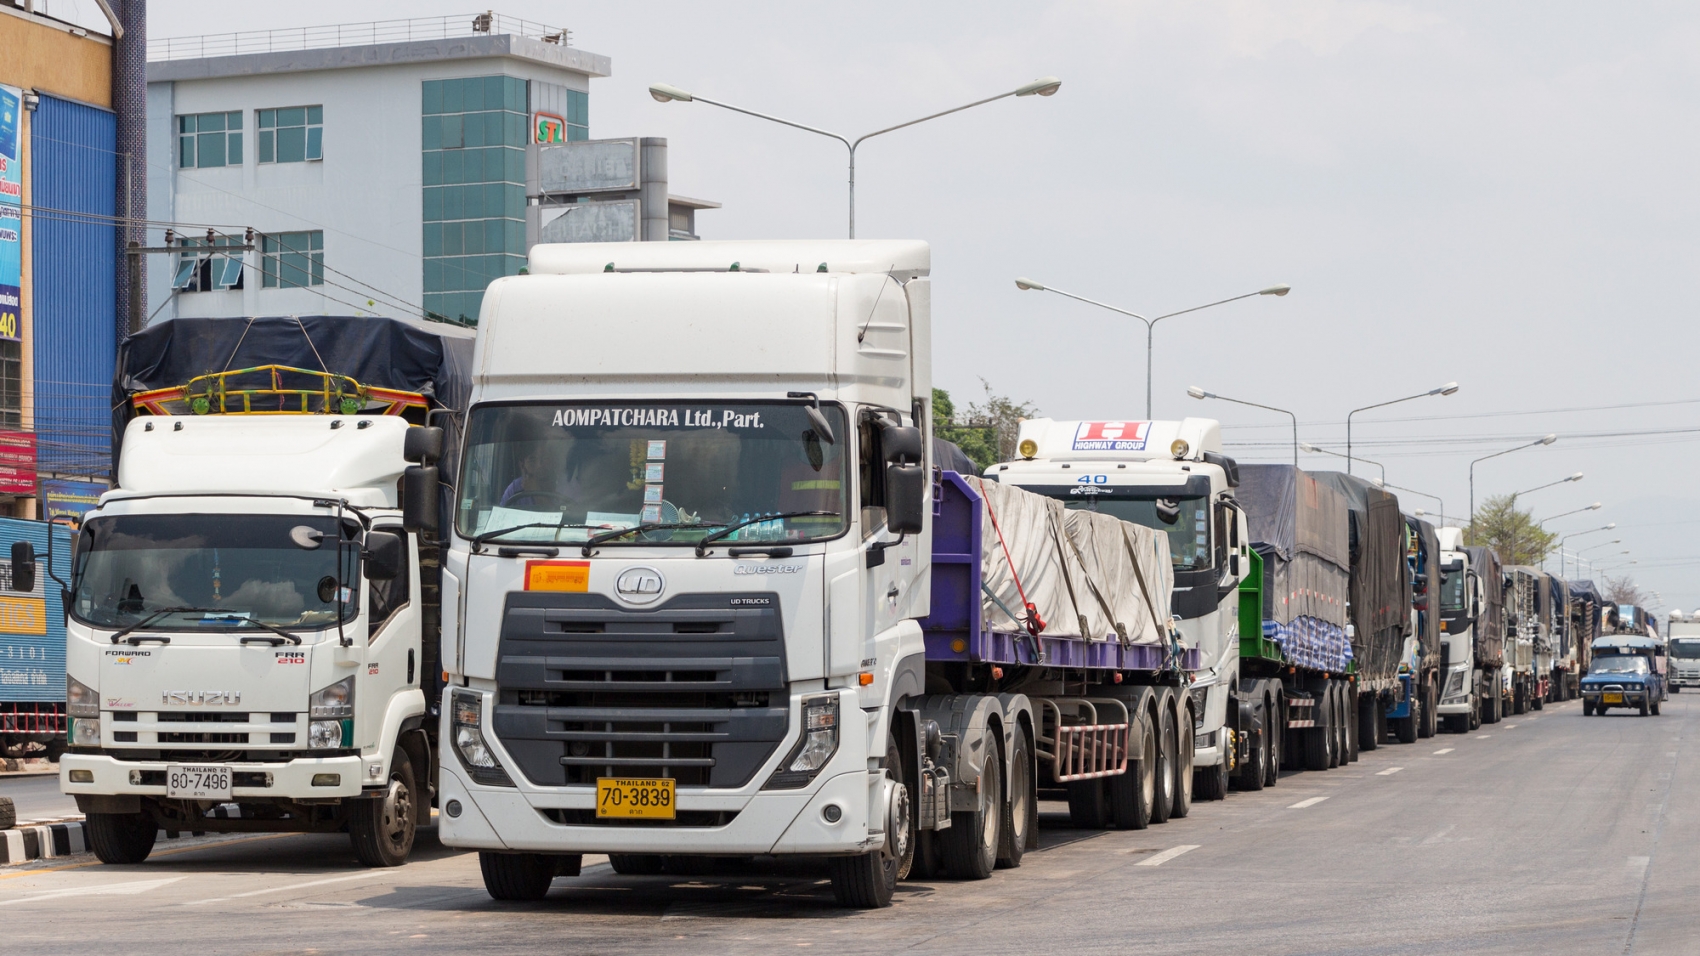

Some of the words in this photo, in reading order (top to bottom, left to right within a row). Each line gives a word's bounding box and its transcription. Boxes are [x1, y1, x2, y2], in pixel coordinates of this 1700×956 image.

[537, 119, 563, 143] STL
[552, 408, 679, 426] AOMPATCHARA
[1078, 421, 1149, 441] H
[1074, 441, 1113, 450] HIGHWAY
[1114, 441, 1145, 450] GROUP
[1077, 474, 1108, 485] 40
[733, 563, 803, 576] Quester
[618, 575, 663, 594] UD
[162, 689, 241, 707] ISUZU
[171, 772, 228, 790] 80-7496
[601, 787, 670, 807] 70-3839
